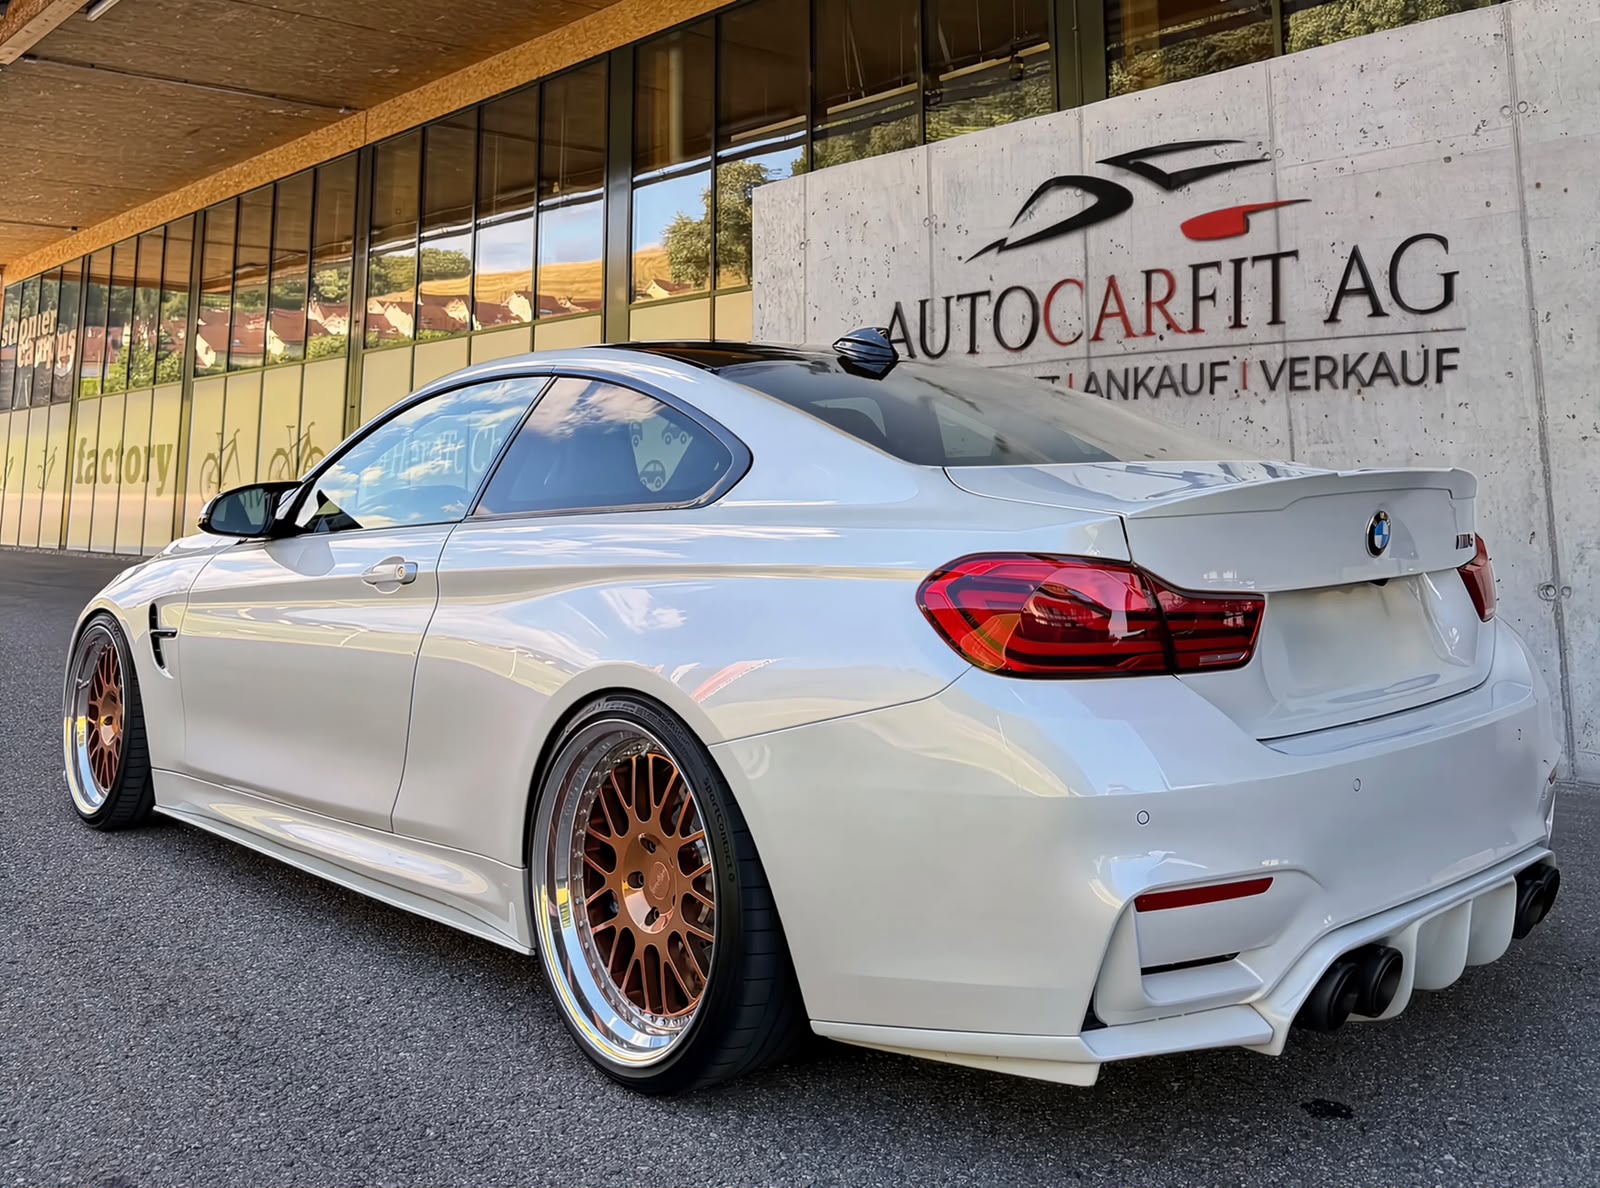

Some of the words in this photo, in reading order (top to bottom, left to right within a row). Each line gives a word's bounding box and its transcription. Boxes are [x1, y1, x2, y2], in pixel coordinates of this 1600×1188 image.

[886, 249, 1299, 361] AUTOCARFIT
[1322, 232, 1460, 326] AG
[1083, 360, 1231, 401] ANKAUF
[1261, 346, 1460, 392] VERKAUF
[75, 437, 173, 497] factory
